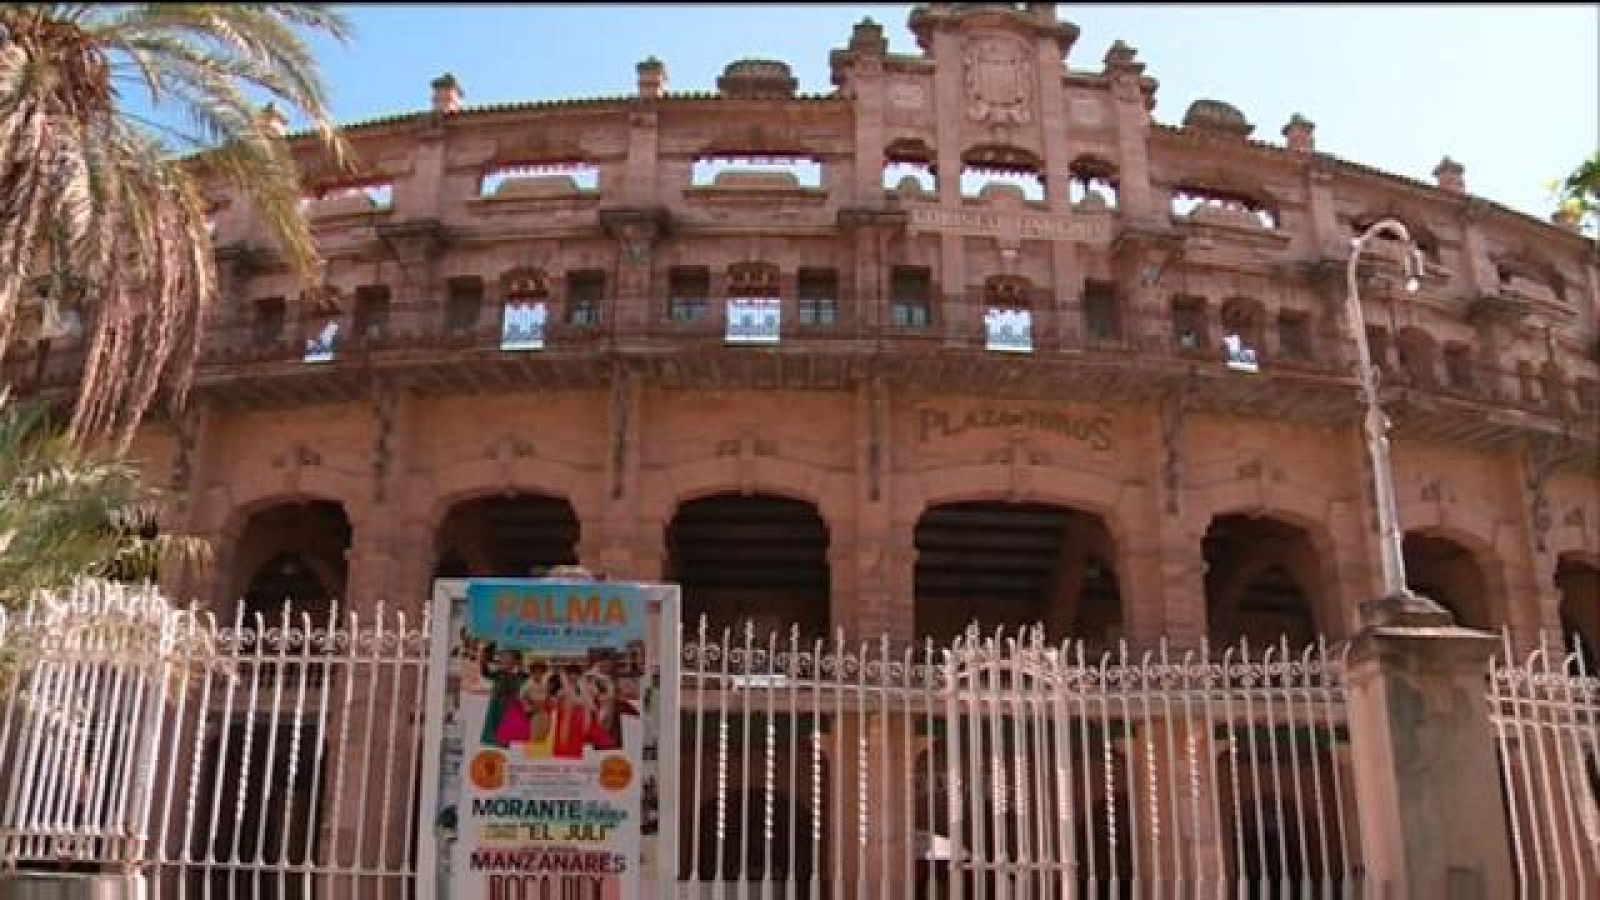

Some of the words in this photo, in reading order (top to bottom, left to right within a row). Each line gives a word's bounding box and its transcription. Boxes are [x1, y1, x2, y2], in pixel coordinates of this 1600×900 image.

[496, 592, 628, 625] PALMA
[472, 798, 581, 820] MORANTE
[470, 851, 627, 873] MANZANARES
